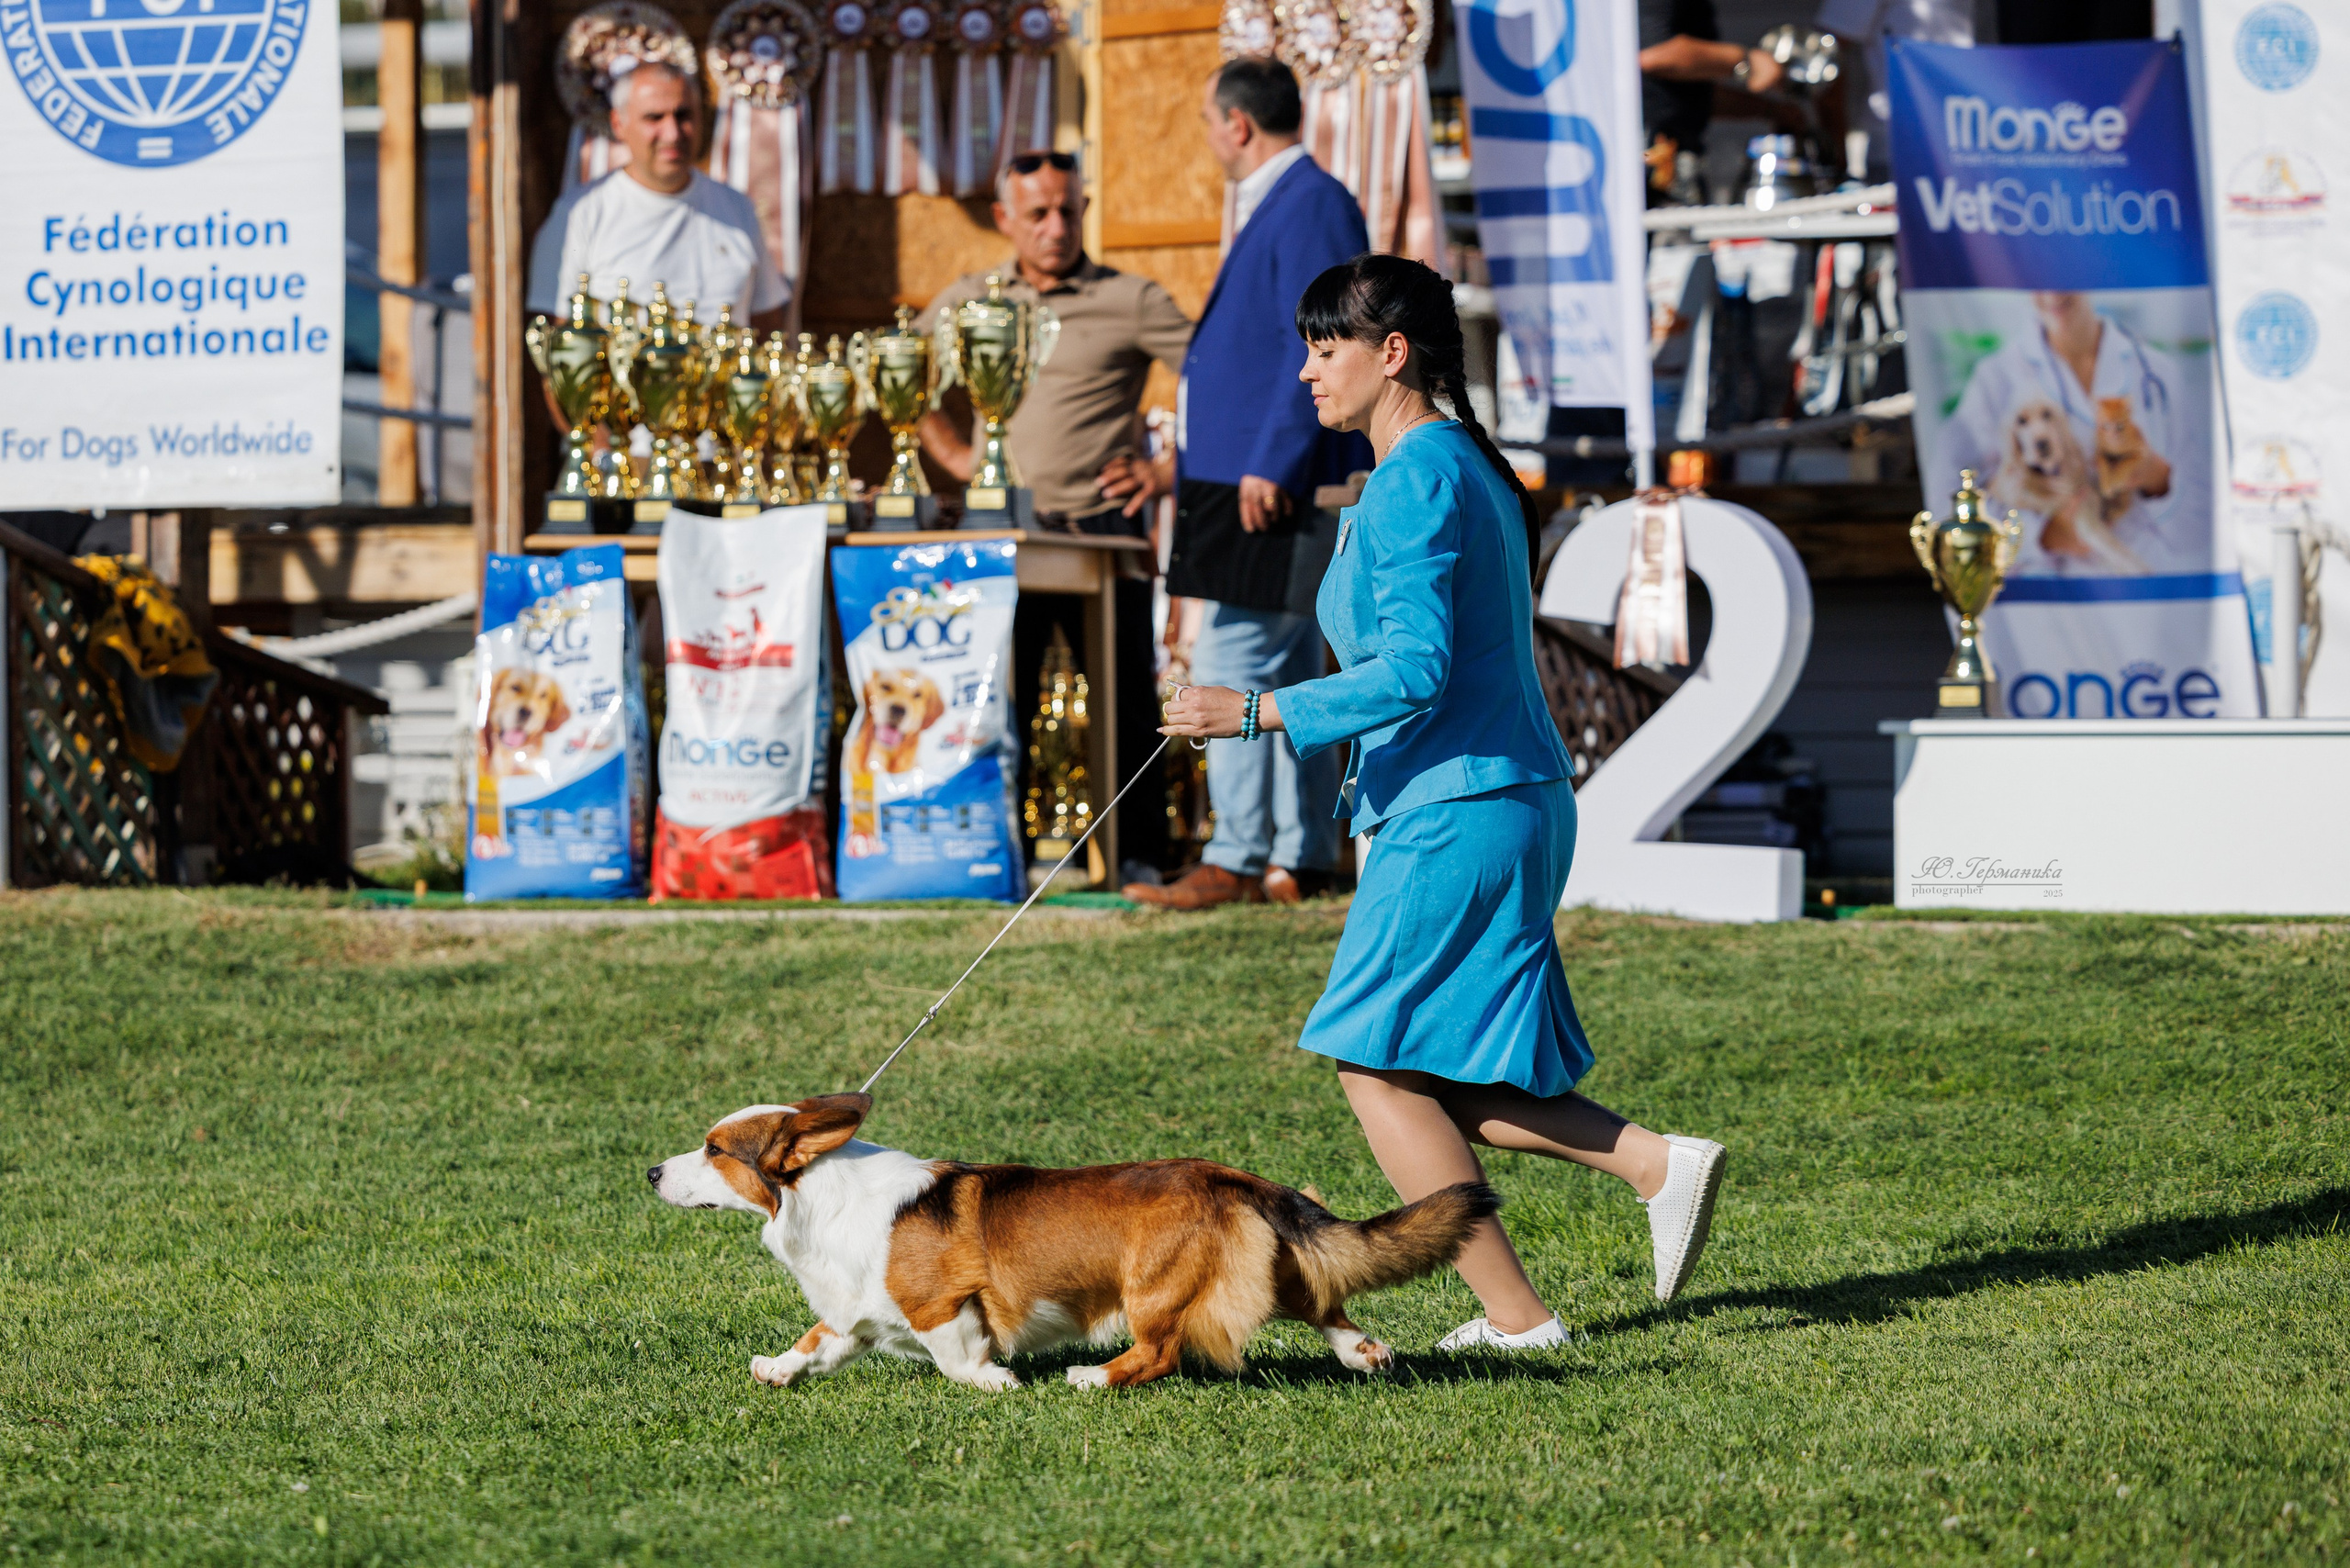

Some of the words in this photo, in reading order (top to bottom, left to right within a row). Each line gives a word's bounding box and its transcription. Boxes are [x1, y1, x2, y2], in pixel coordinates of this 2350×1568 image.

[1914, 176, 2182, 236] VetSolution
[44, 210, 288, 252] Fédération
[26, 264, 307, 317] Cynologique
[4, 314, 329, 361] Internationale
[1, 428, 50, 461] For
[61, 426, 139, 466] Dogs
[149, 420, 314, 457] Worldwide
[881, 614, 971, 651] DOG
[1539, 497, 1814, 923] 2
